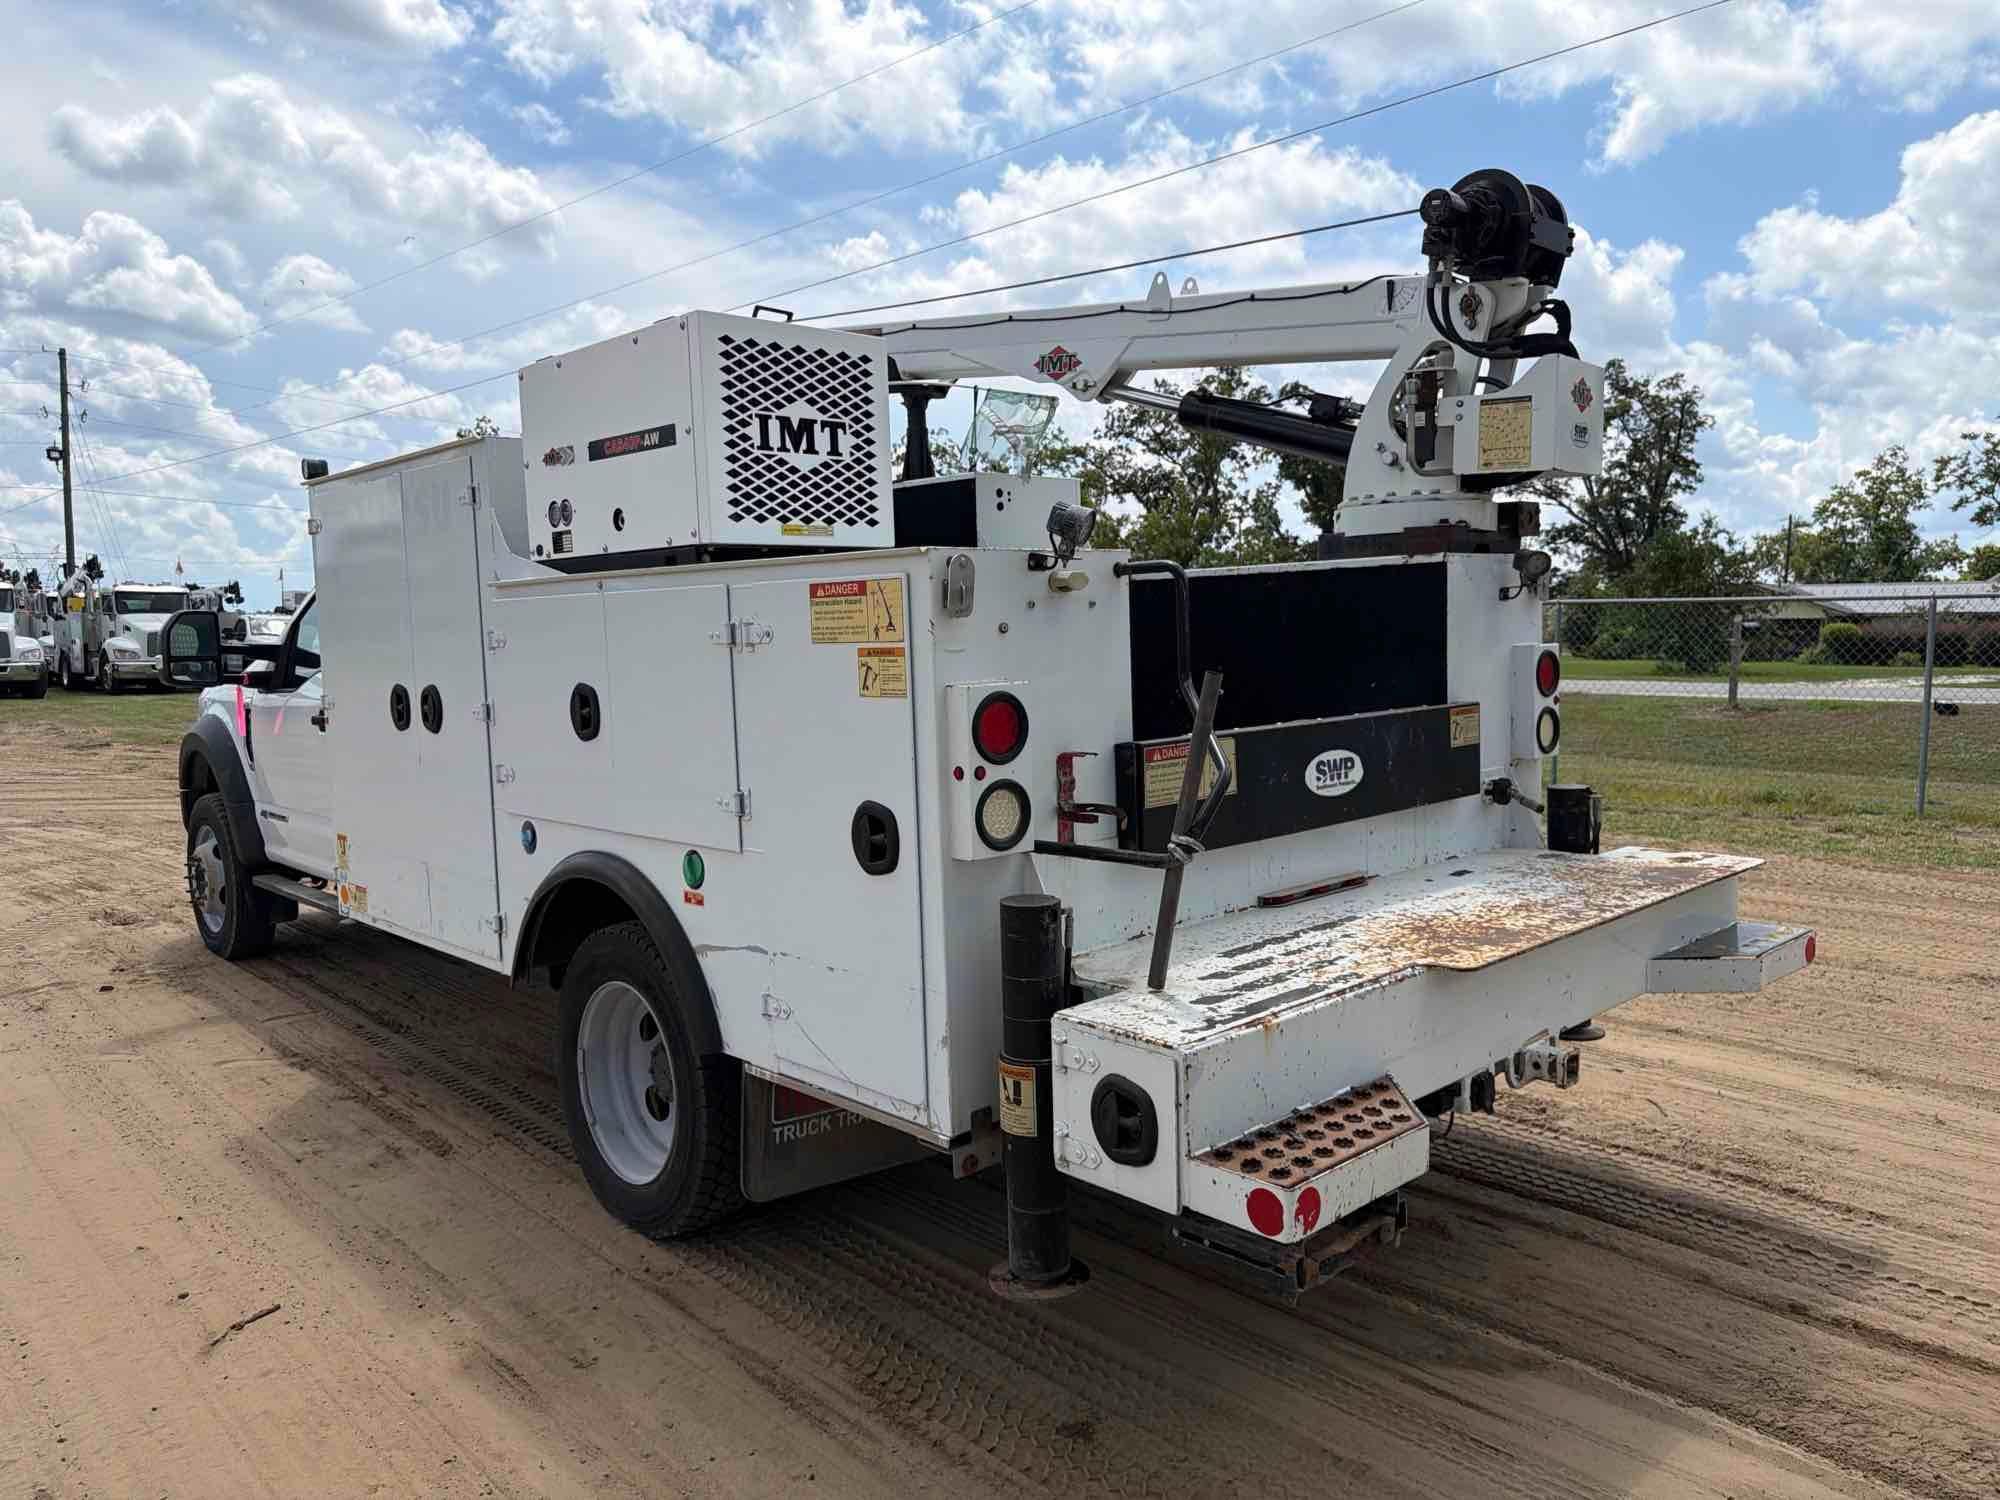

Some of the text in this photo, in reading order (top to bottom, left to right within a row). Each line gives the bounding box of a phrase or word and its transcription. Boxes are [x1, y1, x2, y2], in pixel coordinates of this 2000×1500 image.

[1040, 353, 1077, 373] IMT
[754, 412, 847, 457] IMT
[824, 583, 859, 597] DANGER
[1161, 744, 1191, 760] DANGE
[1315, 757, 1356, 784] SWP
[772, 1114, 832, 1145] TRUCK
